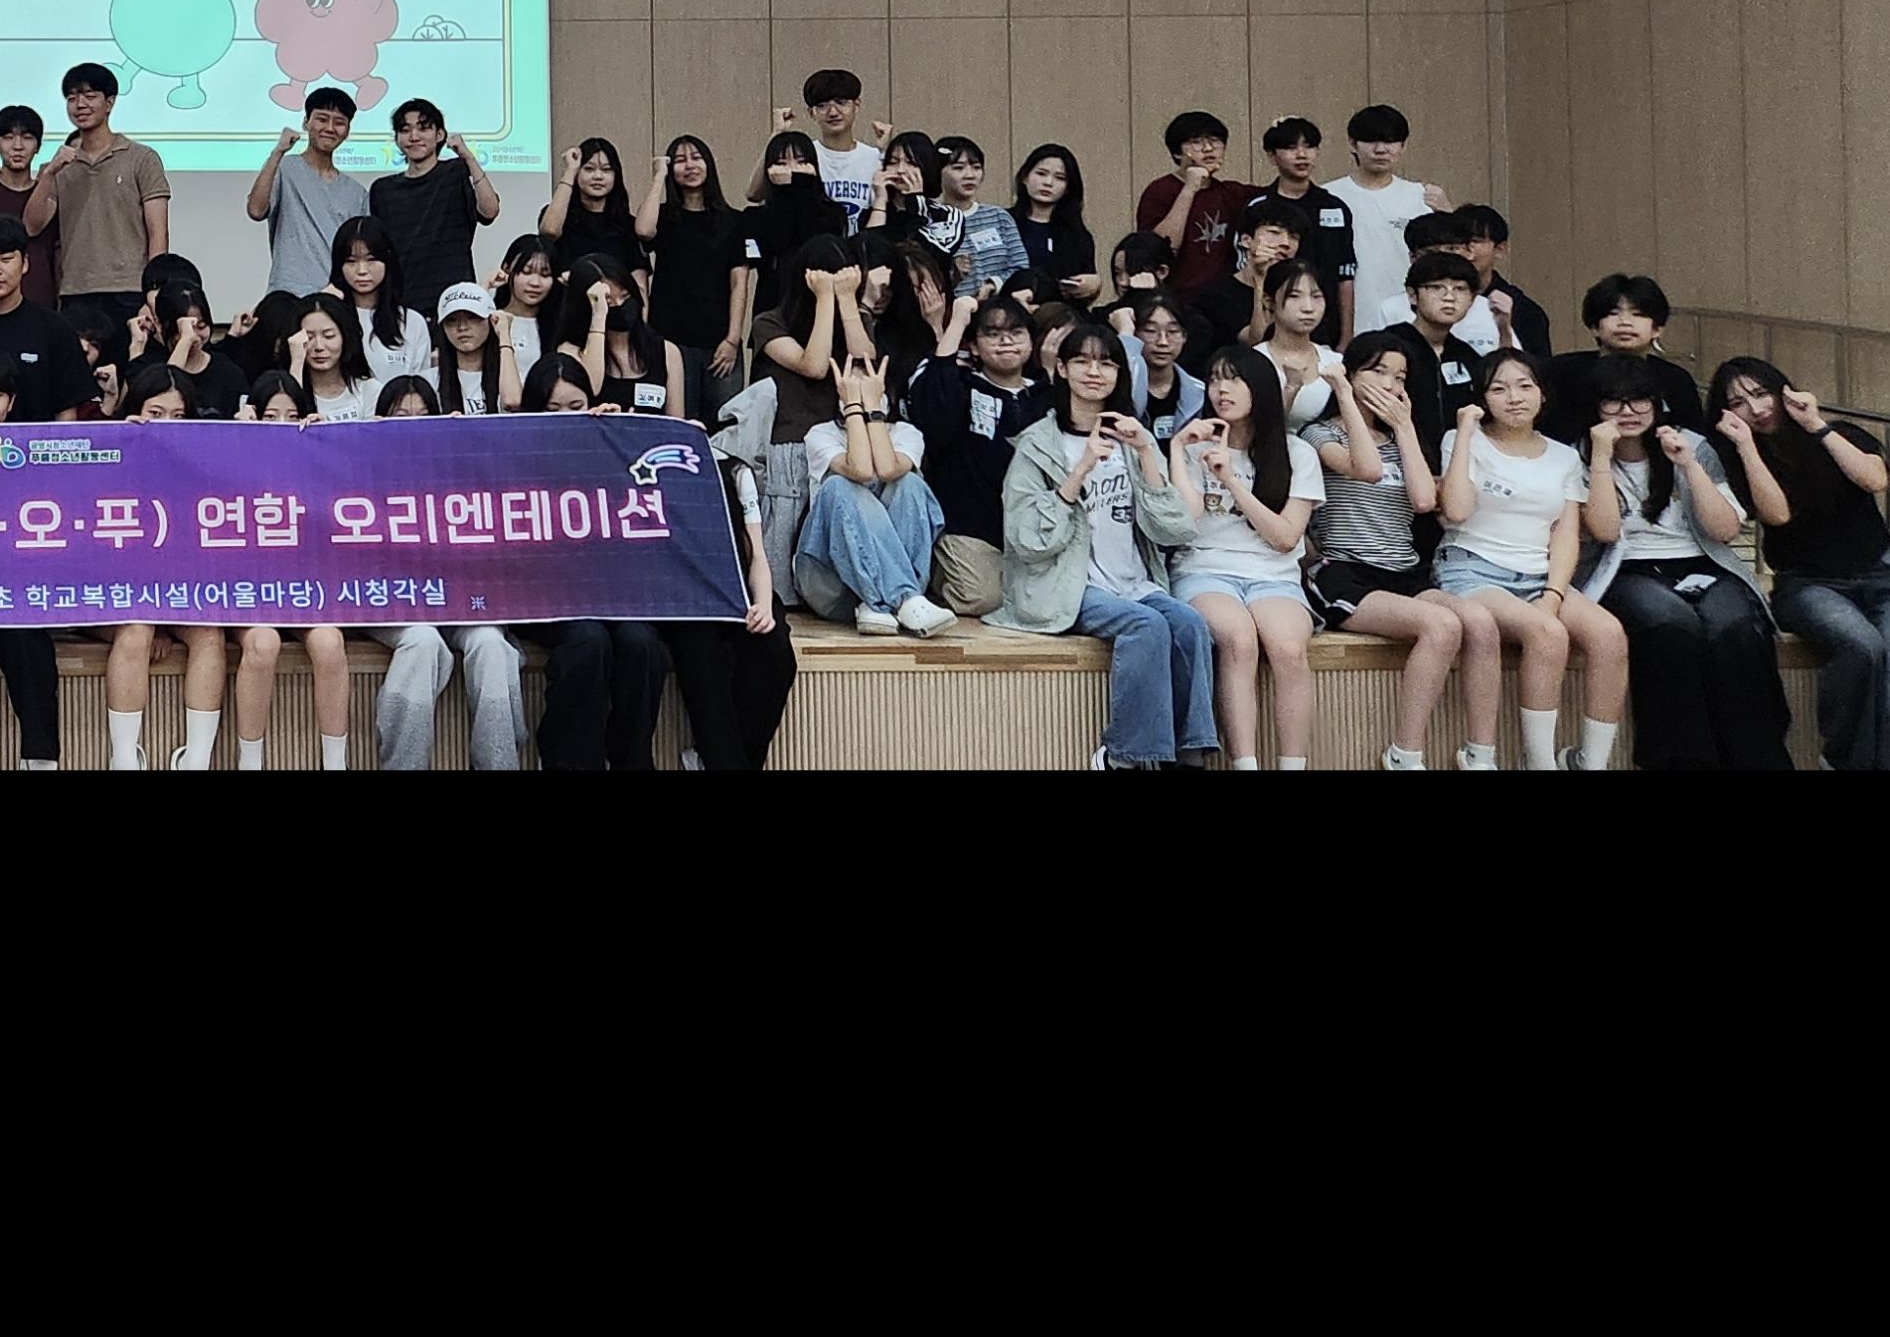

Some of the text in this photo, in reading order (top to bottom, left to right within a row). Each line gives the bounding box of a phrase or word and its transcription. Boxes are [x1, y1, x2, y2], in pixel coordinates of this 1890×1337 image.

[826, 180, 870, 201] VERSIT
[196, 492, 306, 548] 연합
[330, 487, 671, 544] 오리엔테이션
[25, 579, 325, 612] 학교복합시설(어울마당)
[336, 577, 447, 607] 시청각실
